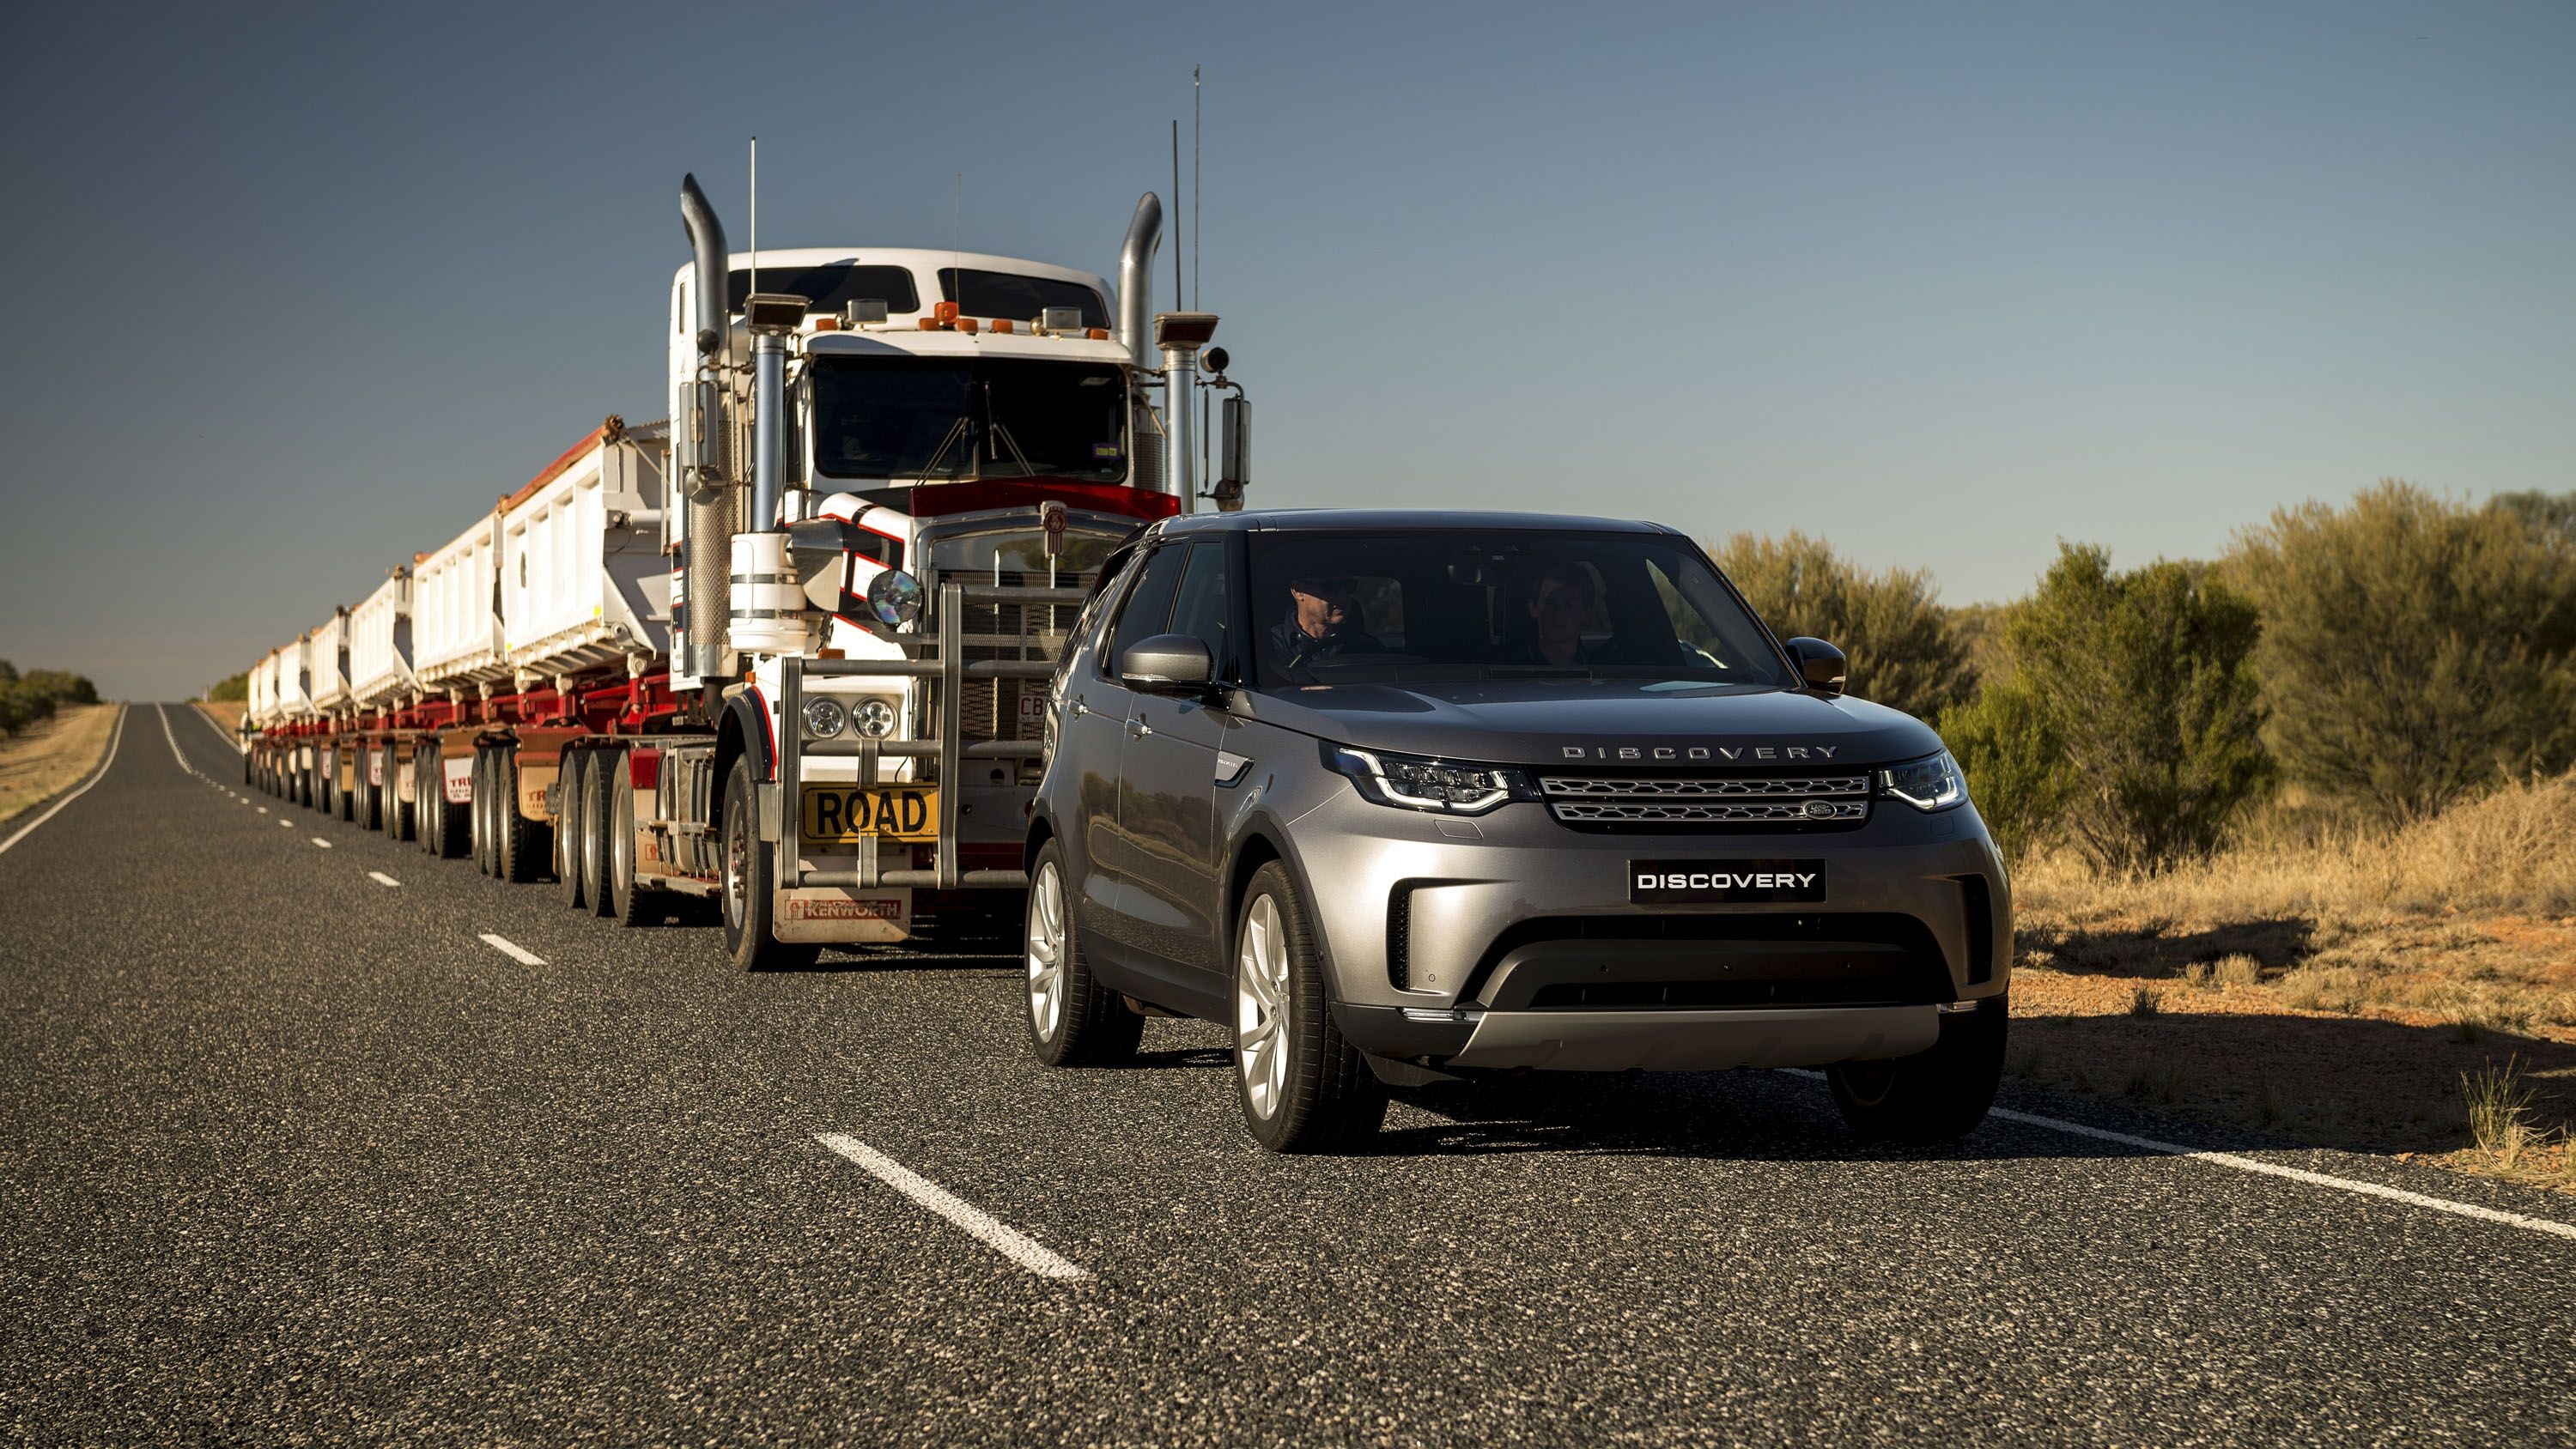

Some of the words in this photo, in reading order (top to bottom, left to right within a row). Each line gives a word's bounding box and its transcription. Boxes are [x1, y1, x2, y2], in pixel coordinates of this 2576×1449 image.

[1020, 697, 1043, 716] CB
[1562, 745, 1838, 760] DISCOVERY
[817, 791, 927, 834] ROAD
[1637, 873, 1816, 889] DISCOVERY
[807, 901, 897, 917] KENWORTH
